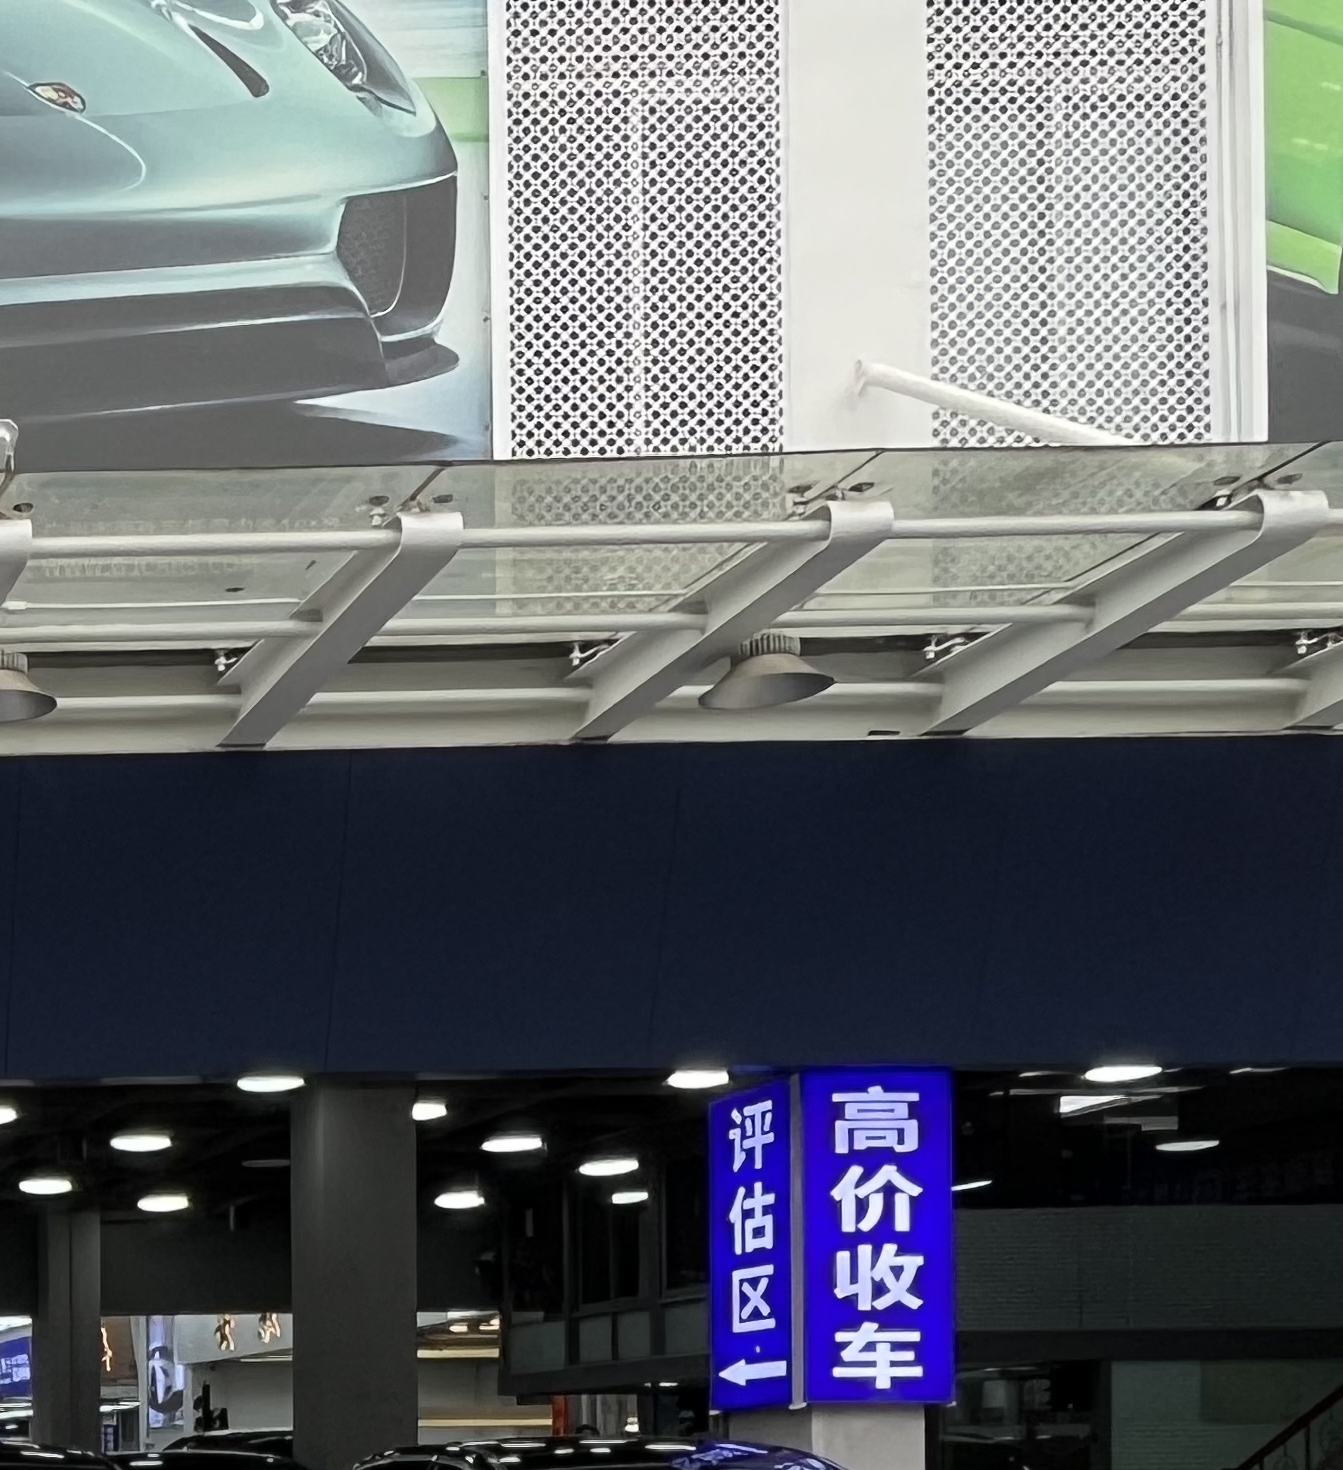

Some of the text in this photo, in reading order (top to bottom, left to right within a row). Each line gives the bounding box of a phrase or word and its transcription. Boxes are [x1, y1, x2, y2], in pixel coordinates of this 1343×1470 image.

[728, 1100, 776, 1333] 评估区
[830, 1085, 924, 1389] 高价收车
